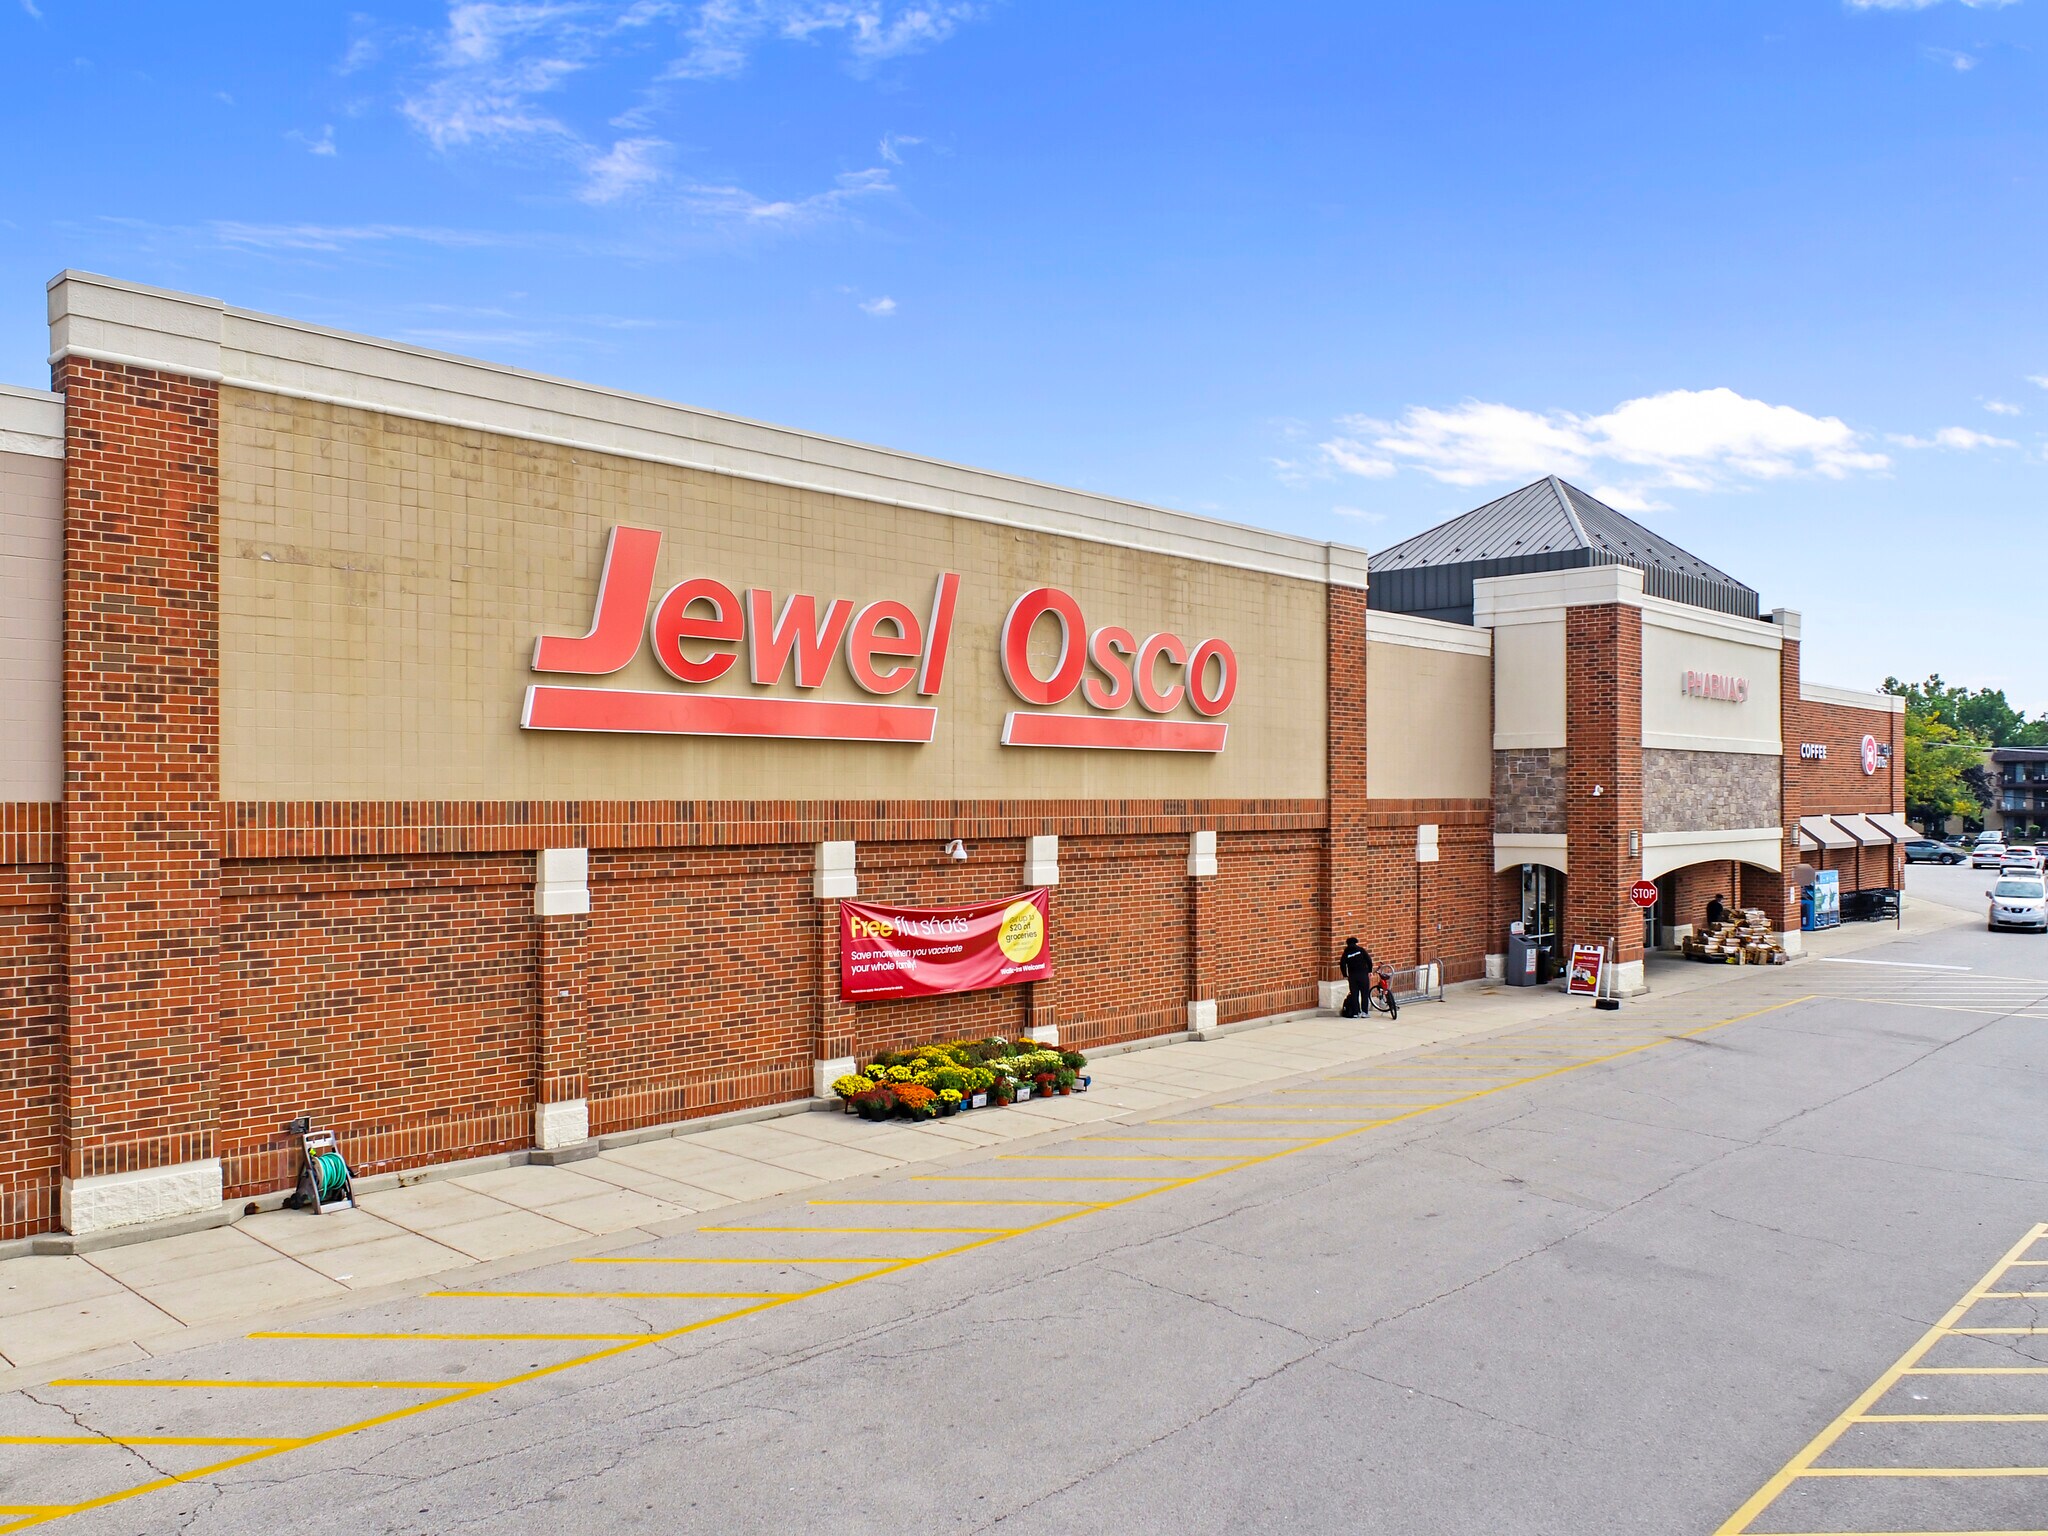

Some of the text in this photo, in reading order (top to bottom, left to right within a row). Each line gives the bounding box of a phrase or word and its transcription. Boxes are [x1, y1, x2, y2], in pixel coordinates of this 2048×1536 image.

[530, 525, 1238, 717] Jewel Osco
[1681, 670, 1749, 703] PHARMACY
[1800, 743, 1827, 759] COFFEE
[1632, 888, 1656, 899] STOP
[850, 916, 894, 938] Free
[894, 915, 919, 936] flu
[1009, 922, 1031, 932] $20 off
[1005, 931, 1038, 943] groceries
[851, 944, 963, 960] Save more when you vaccinate
[851, 963, 870, 976] your
[871, 961, 895, 971] whole
